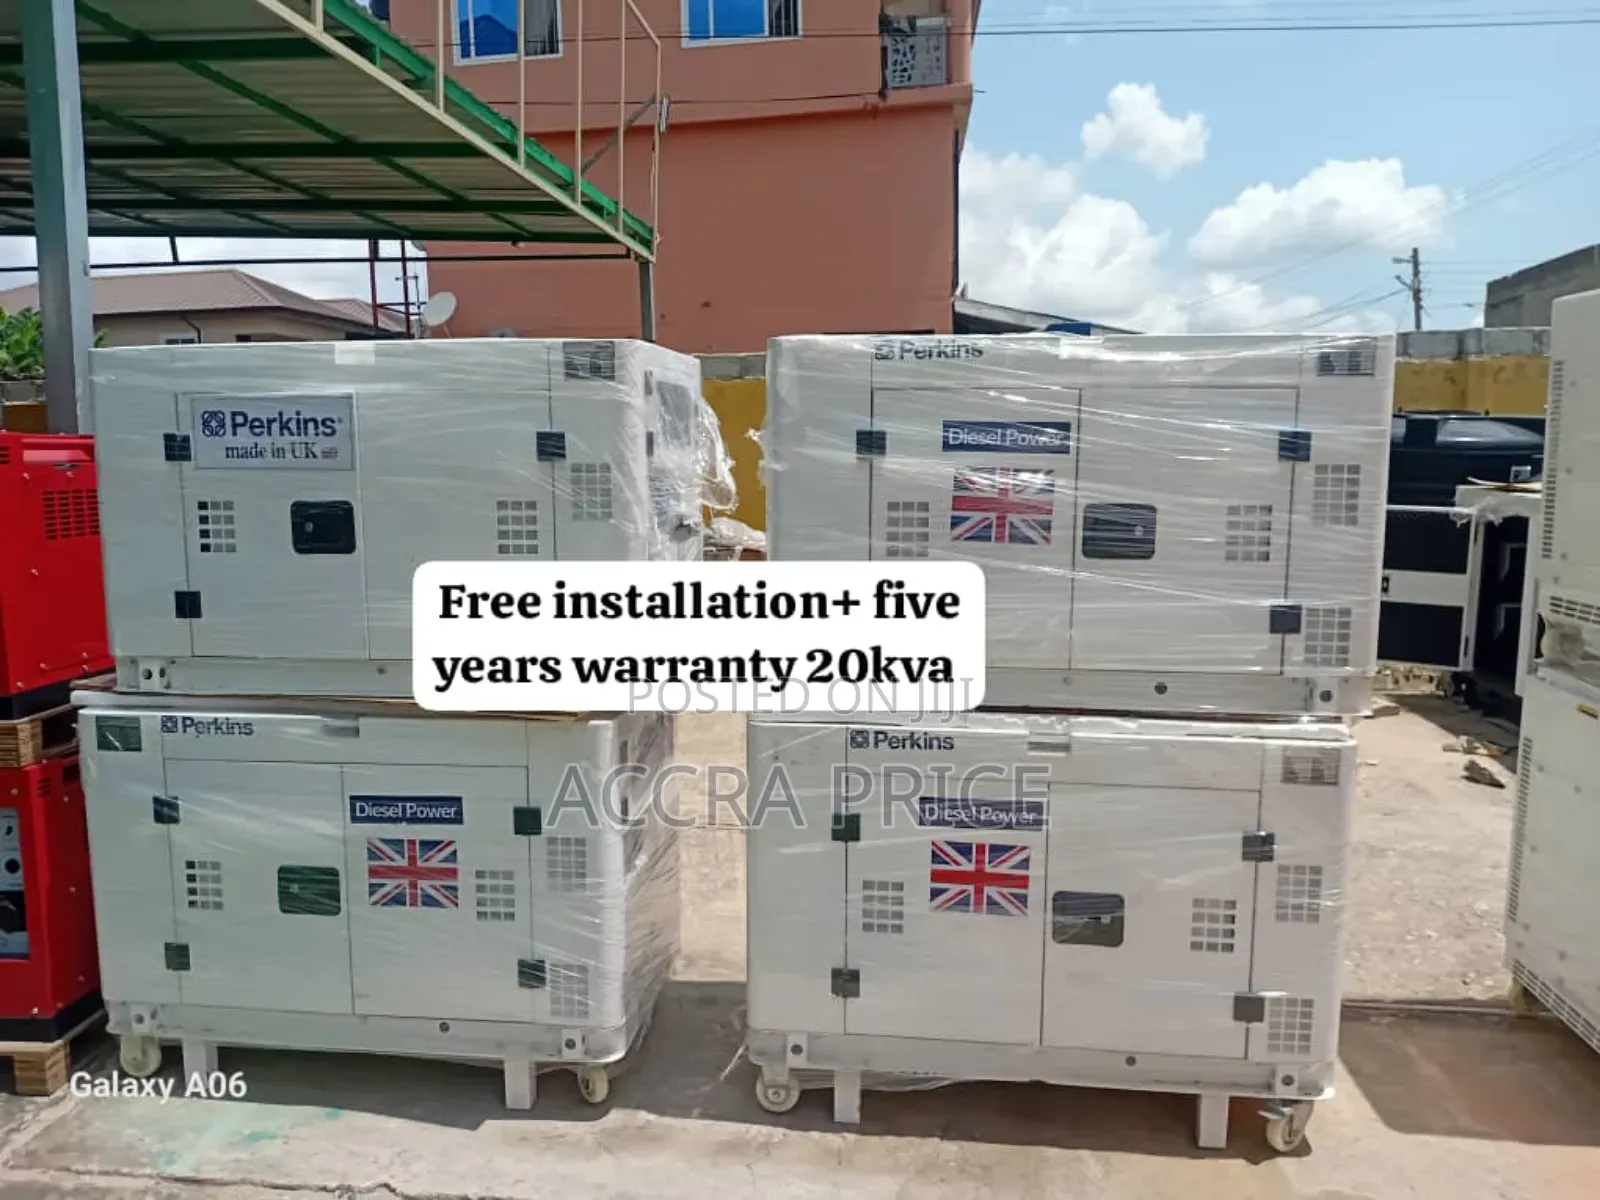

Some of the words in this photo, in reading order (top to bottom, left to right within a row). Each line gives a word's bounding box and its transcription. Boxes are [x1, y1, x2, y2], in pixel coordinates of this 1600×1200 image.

[901, 339, 984, 360] Perkins
[230, 410, 337, 437] Perkins
[949, 428, 1000, 445] Diesel
[1006, 430, 1065, 446] Power
[225, 442, 265, 459] made
[271, 442, 286, 459] in
[291, 442, 318, 459] UK
[181, 716, 254, 736] Perkins
[873, 731, 954, 750] Perkins
[355, 802, 402, 817] Diesel
[405, 802, 457, 818] Power
[924, 804, 975, 821] Diesel
[979, 806, 1035, 825] Power
